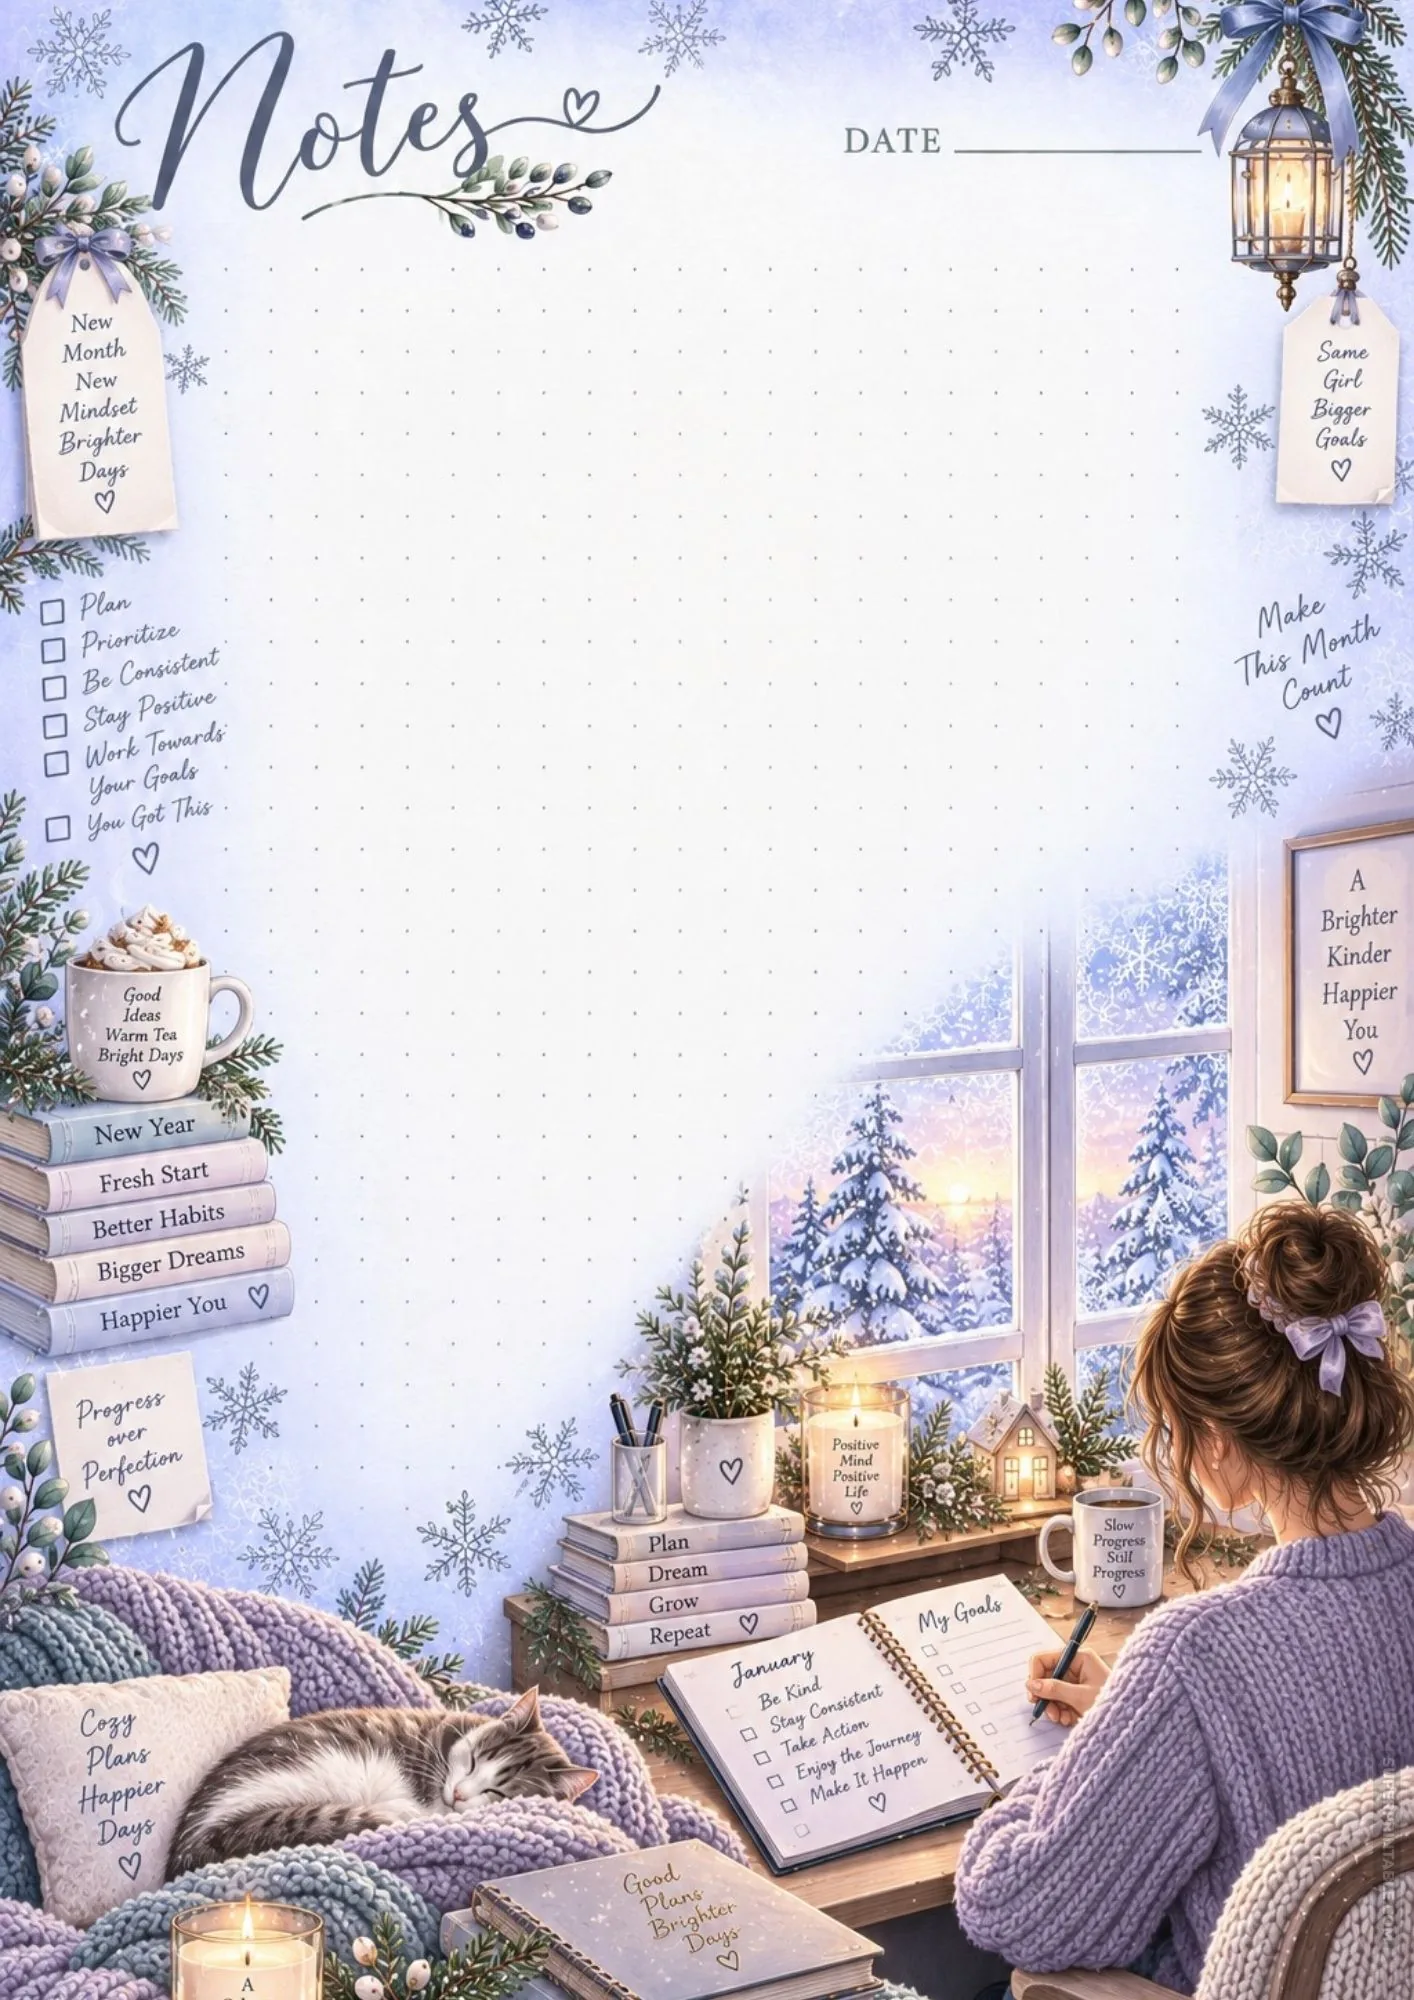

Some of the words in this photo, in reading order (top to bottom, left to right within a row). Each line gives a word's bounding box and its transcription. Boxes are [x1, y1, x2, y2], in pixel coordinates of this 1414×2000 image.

[114, 31, 488, 212] Notes
[844, 128, 941, 153] DATE
[72, 314, 113, 332] New
[62, 338, 126, 363] Month
[1317, 340, 1370, 363] Same
[76, 372, 117, 390] New
[1323, 369, 1363, 390] Girl
[59, 398, 138, 423] Mindset
[1311, 399, 1372, 424] Bigger
[59, 428, 143, 457] Brighter
[1315, 428, 1368, 450] Goals
[79, 461, 129, 487] Days
[81, 592, 131, 621] Plan
[1258, 594, 1326, 638] Make
[82, 624, 180, 658] Prioritize
[1234, 649, 1291, 686] This
[1302, 614, 1381, 664] Month
[82, 669, 112, 695] Be
[120, 648, 220, 686] Consistent
[1282, 664, 1353, 710] Count
[84, 706, 130, 732] Stay
[139, 691, 216, 722] Positive
[86, 737, 139, 768] Work
[146, 721, 226, 749] Towards
[90, 776, 135, 804] Your
[144, 759, 198, 792] Goals
[88, 812, 124, 841] You
[132, 804, 164, 831] Got
[172, 796, 213, 822] This
[1350, 869, 1365, 891] A
[1321, 904, 1399, 936] Brighter
[1327, 941, 1392, 967] Kinder
[124, 987, 162, 1006] Good
[1323, 982, 1398, 1011] Happier
[123, 1008, 160, 1022] Ideas
[106, 1028, 148, 1042] Warm
[153, 1028, 177, 1041] Tea
[1343, 1019, 1378, 1041] You
[98, 1048, 144, 1067] Bright
[149, 1048, 183, 1065] Days
[94, 1126, 142, 1145] New
[149, 1117, 195, 1137] Year
[100, 1169, 154, 1193] Fresh
[162, 1163, 209, 1181] Start
[92, 1218, 153, 1239] Better
[160, 1205, 225, 1229] Habits
[98, 1259, 161, 1283] Bigger
[167, 1245, 245, 1270] Dreams
[100, 1305, 181, 1332] Happier
[188, 1297, 227, 1315] You
[76, 1392, 165, 1429] Progress
[108, 1427, 147, 1447] over
[832, 1438, 879, 1451] Positive
[82, 1450, 183, 1490] Perfection
[840, 1454, 873, 1466] Mind
[833, 1470, 880, 1481] Positive
[845, 1486, 868, 1498] Life
[1104, 1518, 1134, 1531] Slow
[649, 1534, 689, 1553] Plan
[1093, 1534, 1146, 1550] Progress
[649, 1564, 708, 1583] Dream
[1093, 1566, 1145, 1580] Progress
[649, 1596, 699, 1614] Grow
[919, 1610, 950, 1634] My
[954, 1594, 1002, 1623] Goals
[650, 1623, 711, 1646] Repeat
[731, 1649, 814, 1688] January
[758, 1692, 781, 1712] Be
[785, 1676, 822, 1700] Kind
[81, 1708, 136, 1738] Cozy
[770, 1711, 806, 1735] Stay
[809, 1684, 884, 1720] Consistent
[780, 1735, 816, 1757] Take
[822, 1719, 869, 1745] Action
[87, 1744, 151, 1776] Plans
[796, 1758, 836, 1782] Enjoy
[840, 1746, 863, 1764] the
[867, 1729, 922, 1757] Journey
[810, 1782, 850, 1805] Make
[856, 1772, 869, 1789] It
[873, 1755, 928, 1783] Happen
[78, 1781, 165, 1814] Happier
[97, 1819, 155, 1846] Days
[623, 1863, 681, 1895] Good
[640, 1891, 704, 1916] Plans
[648, 1904, 737, 1940] Brighter
[682, 1928, 741, 1953] Days
[241, 1977, 254, 1991] A
